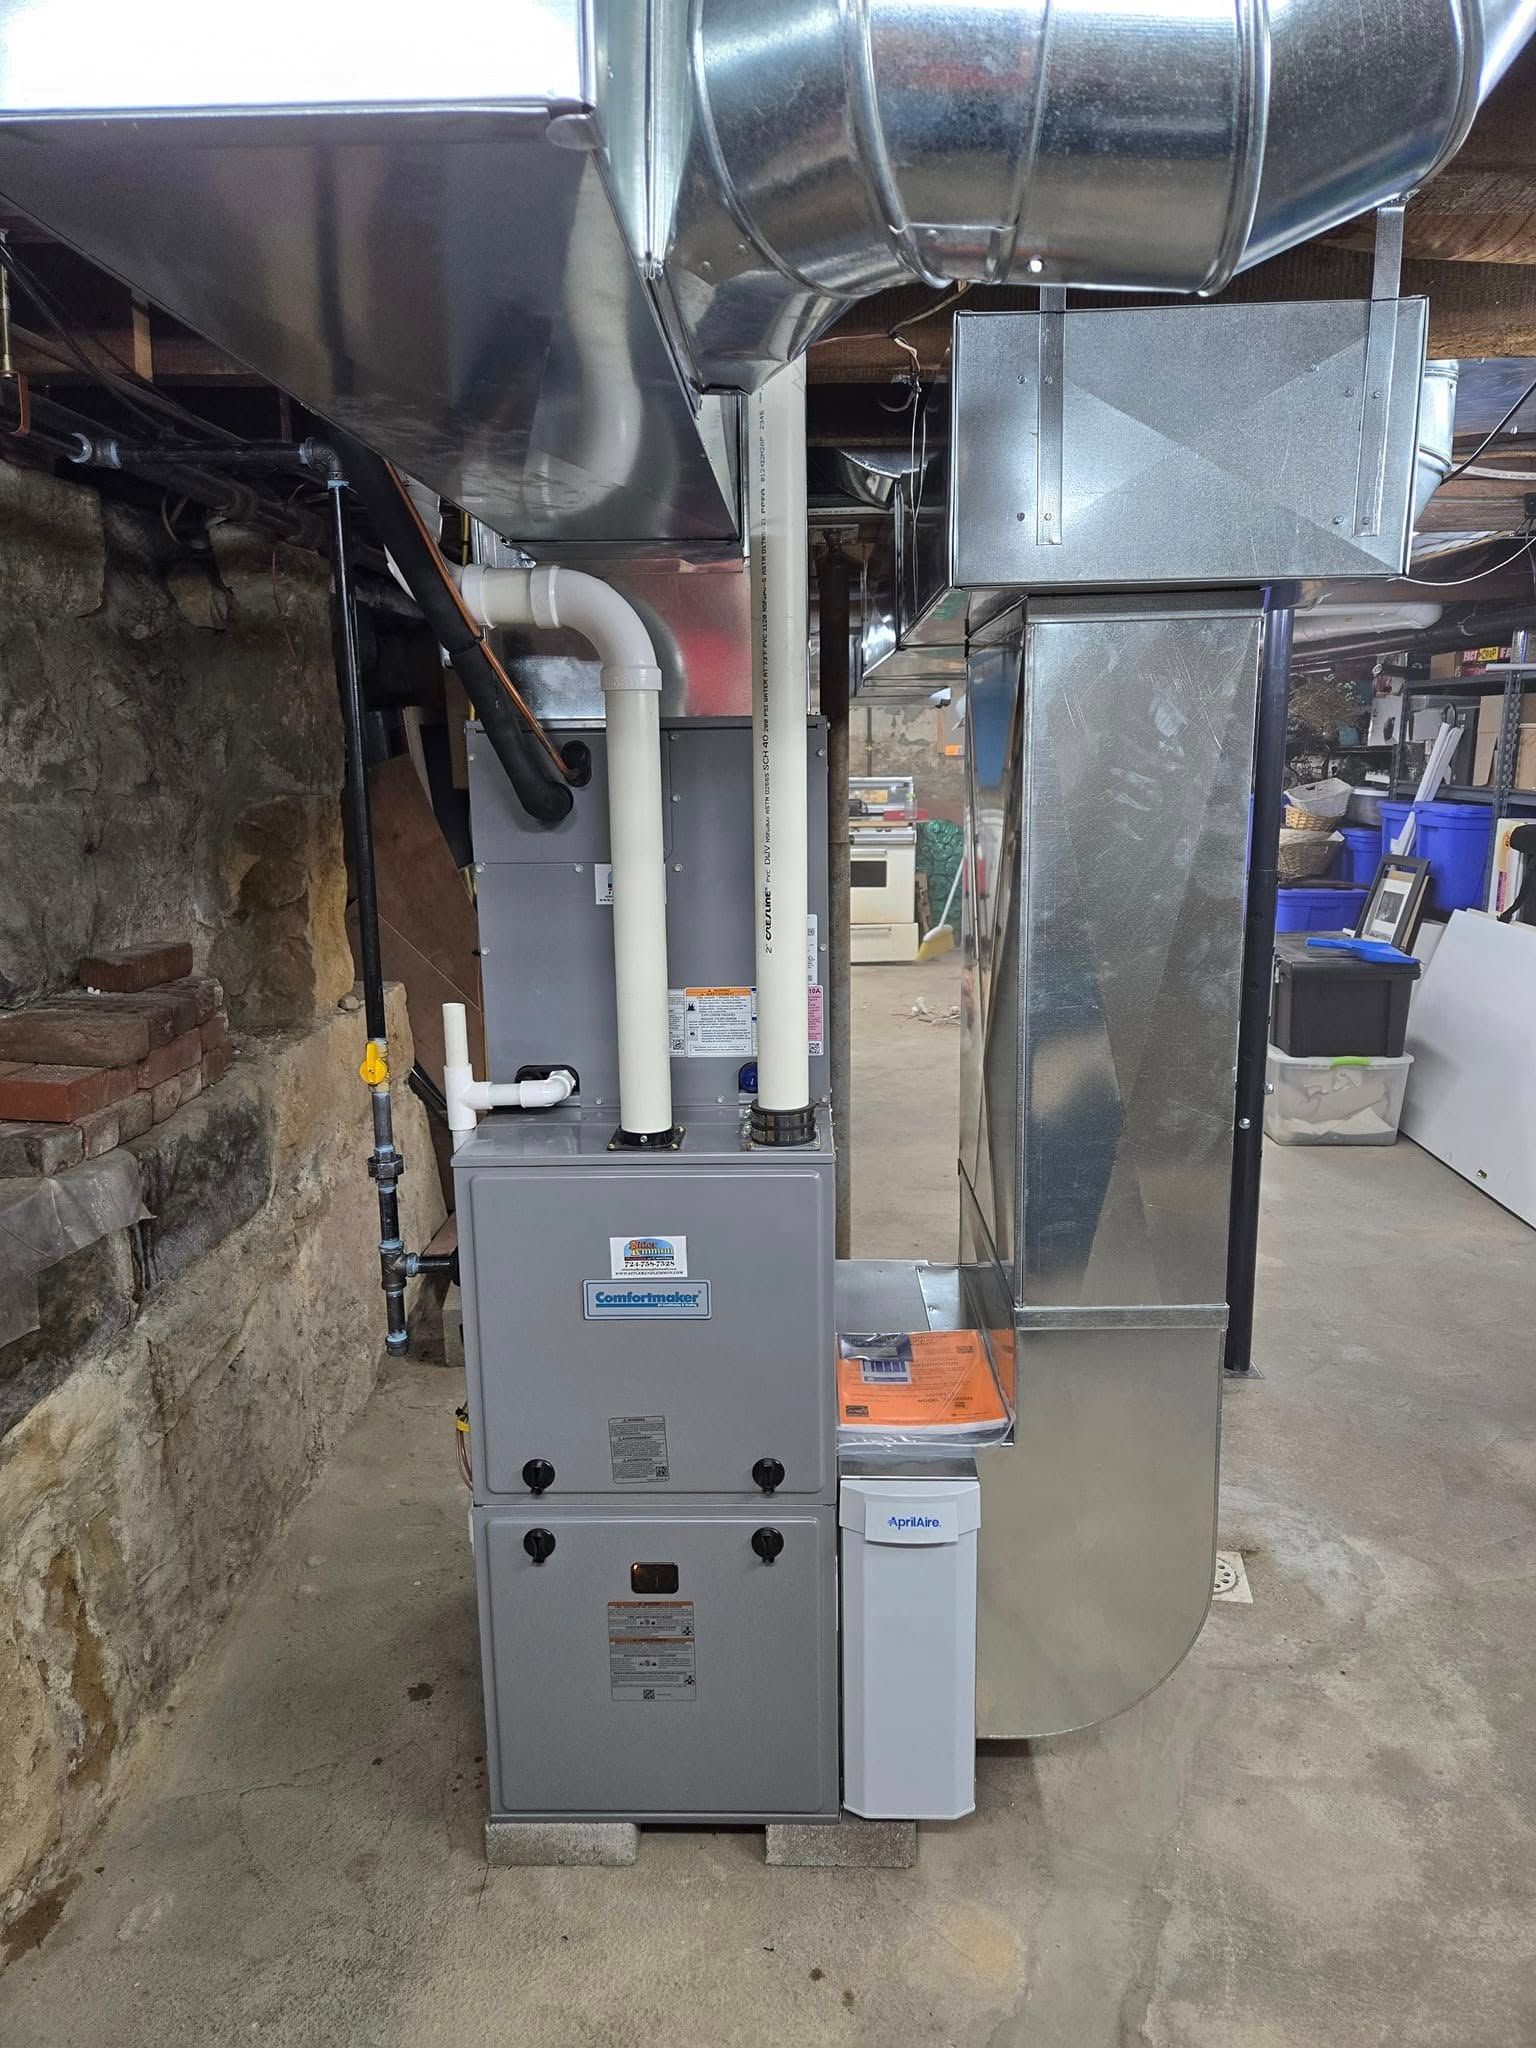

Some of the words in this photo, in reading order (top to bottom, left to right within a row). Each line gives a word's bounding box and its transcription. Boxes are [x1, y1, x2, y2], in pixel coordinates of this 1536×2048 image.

[762, 734, 769, 749] 40
[595, 1291, 699, 1303] Comfortmaker
[887, 1516, 940, 1530] AprilAire
